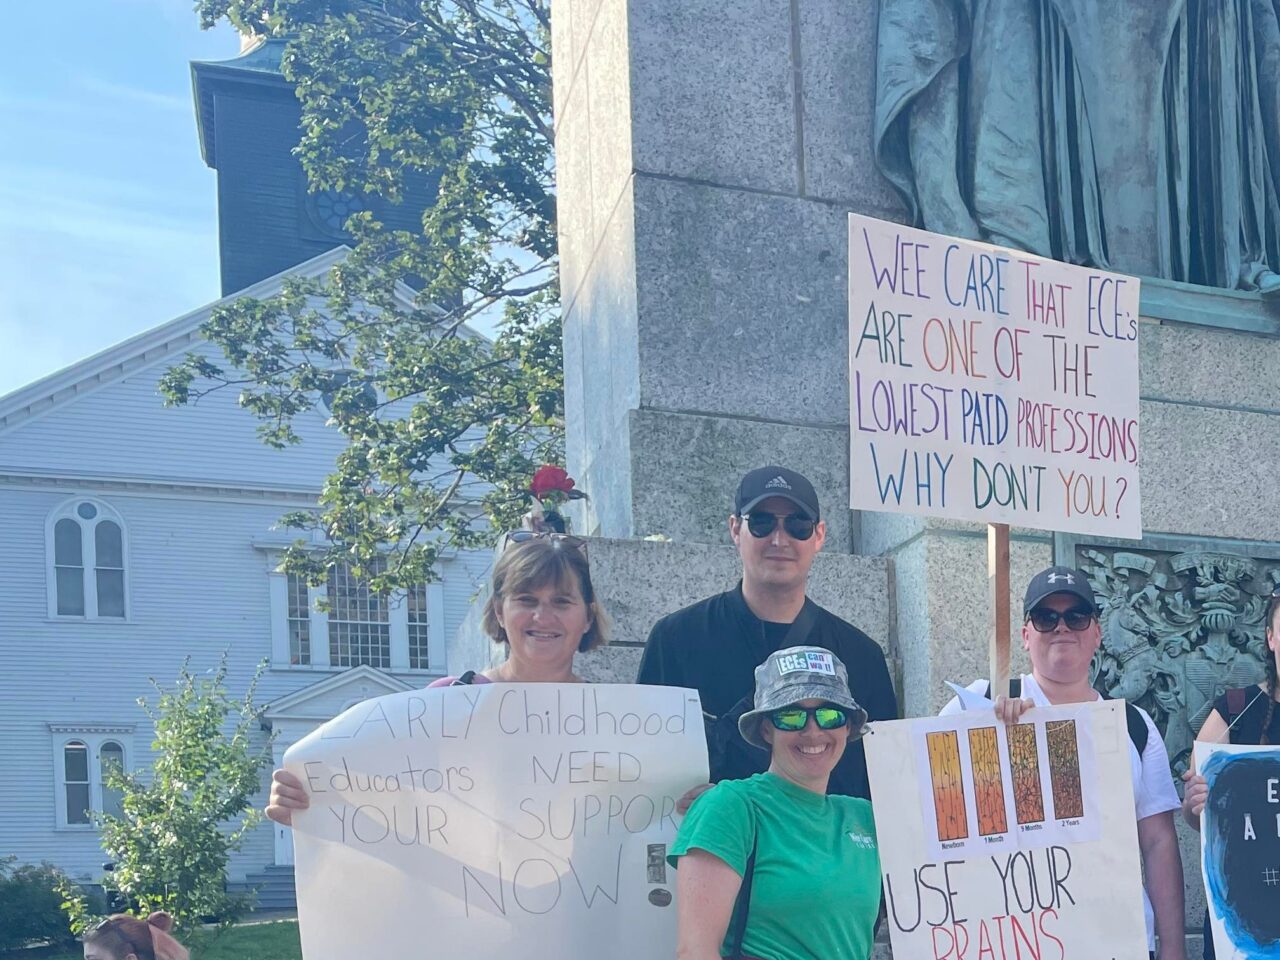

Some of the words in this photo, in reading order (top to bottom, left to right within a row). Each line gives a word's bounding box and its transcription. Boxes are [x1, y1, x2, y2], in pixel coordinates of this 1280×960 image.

[863, 227, 930, 298] WEE
[944, 245, 1009, 314] CARE
[1018, 260, 1072, 328] THAT
[855, 301, 912, 367] ARE
[923, 318, 986, 378] ONE
[994, 327, 1030, 381] OF
[1043, 334, 1099, 398] THE
[856, 370, 953, 440] LOWEST
[961, 388, 1008, 445] PAID
[870, 442, 953, 507] WHY
[973, 457, 1046, 512] DON'T
[1058, 468, 1127, 519] YOU?
[499, 688, 686, 736] Childhood
[304, 756, 474, 793] Educators
[532, 751, 641, 784] NEED
[329, 805, 448, 846] YOUR
[519, 794, 679, 841] SUPPOR
[1066, 819, 1080, 827] Years
[1243, 813, 1257, 841] A
[886, 860, 967, 932] USE
[991, 845, 1076, 917] YOUR
